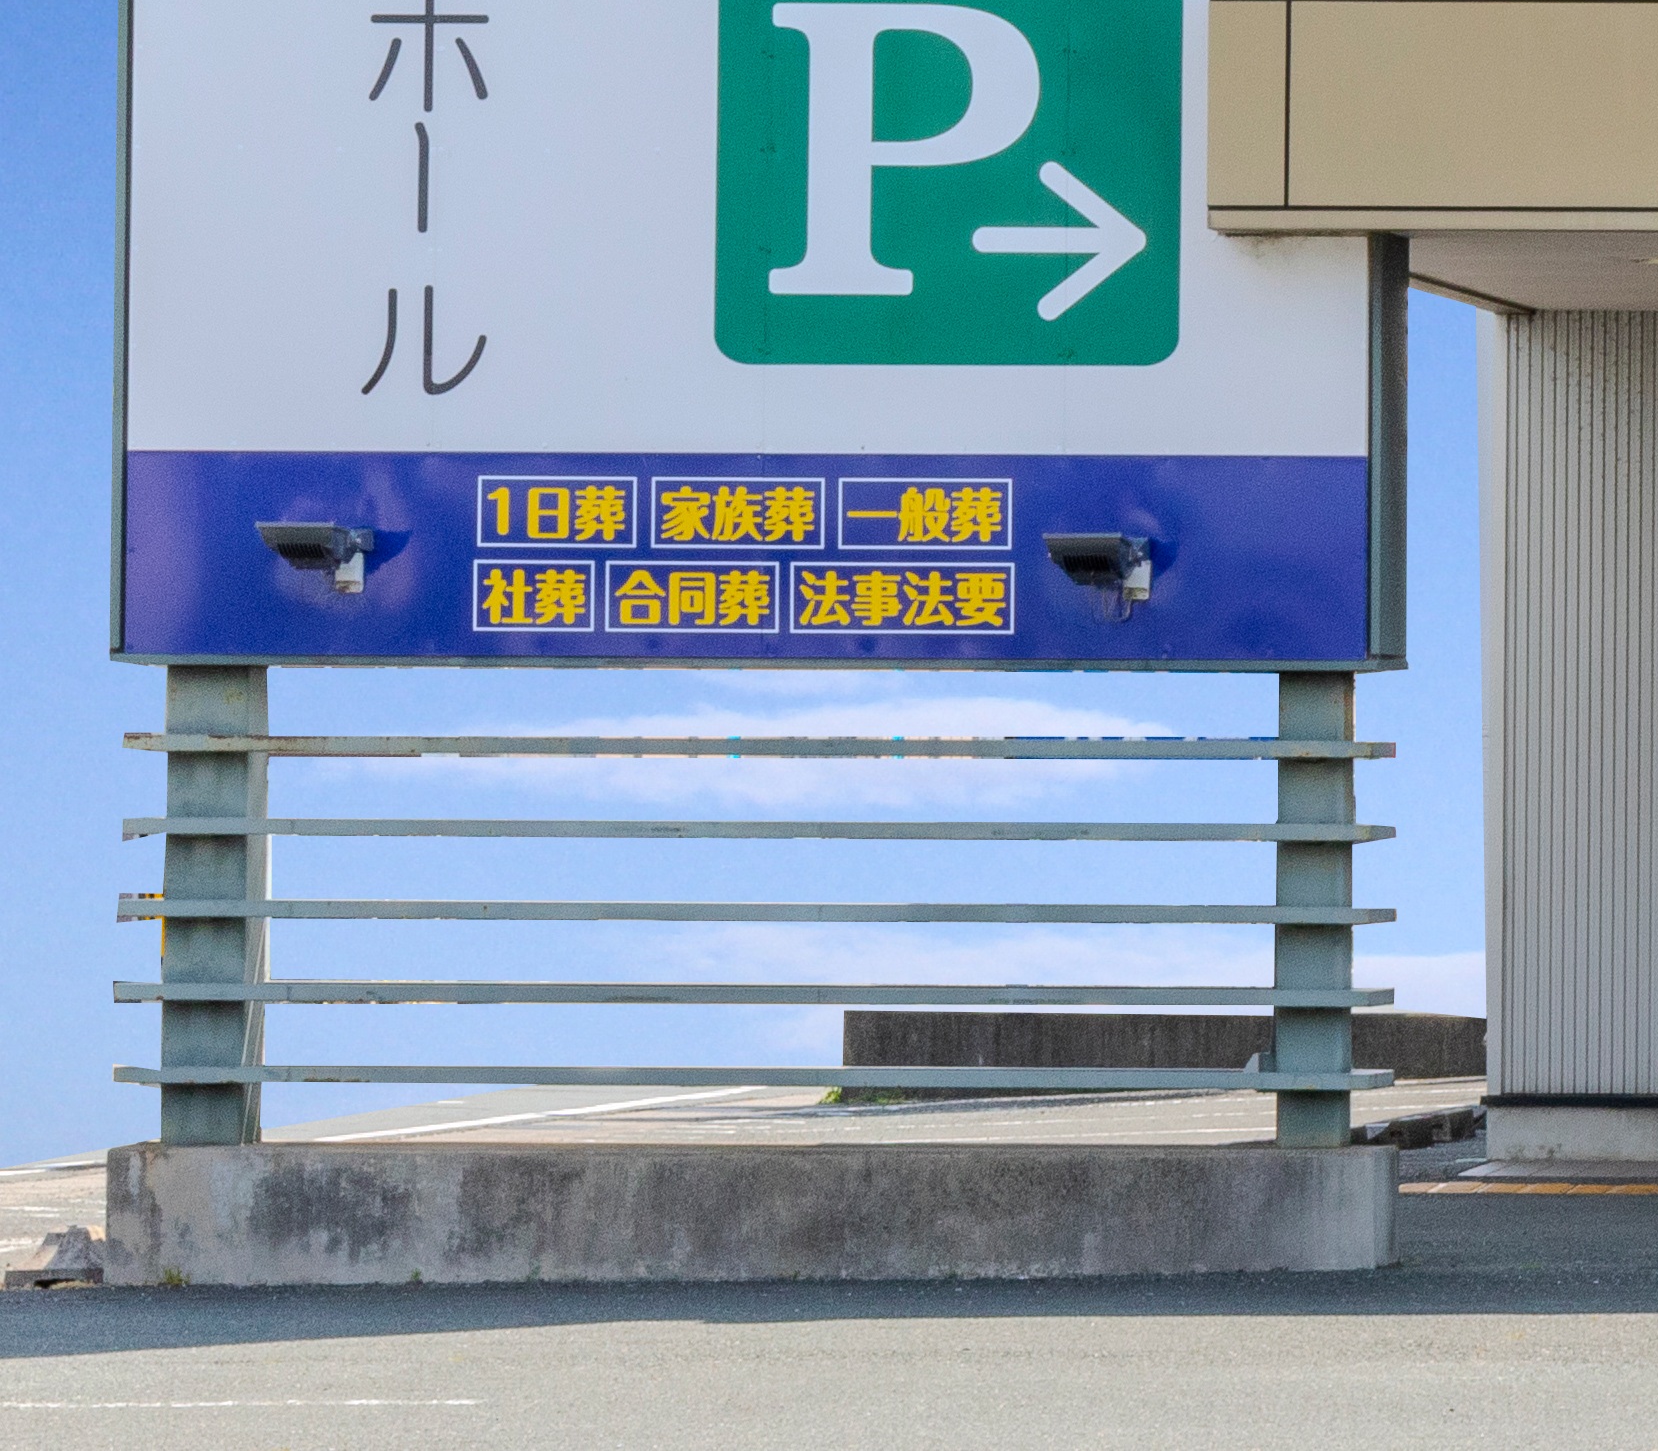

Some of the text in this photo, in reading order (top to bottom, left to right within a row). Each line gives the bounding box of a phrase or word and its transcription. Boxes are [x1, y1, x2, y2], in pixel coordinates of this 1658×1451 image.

[768, 2, 1041, 296] P
[487, 485, 1002, 542] 1日葬 家族葬 一般葬
[482, 568, 1007, 627] 社葬 合同葬 法事法要
